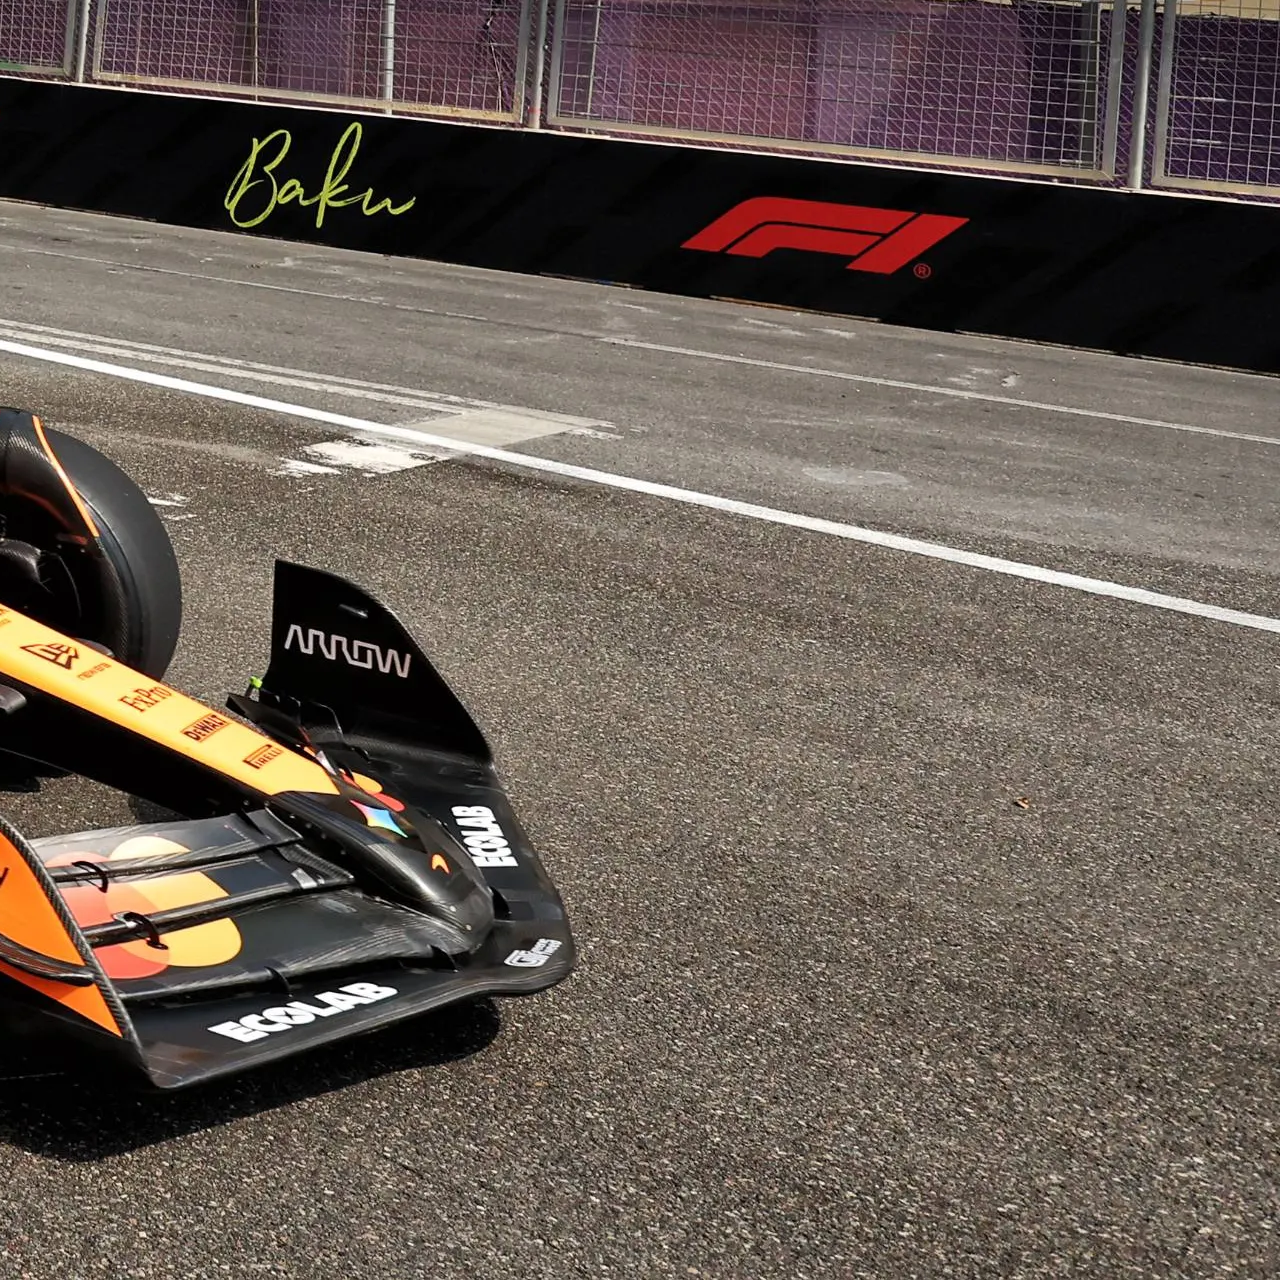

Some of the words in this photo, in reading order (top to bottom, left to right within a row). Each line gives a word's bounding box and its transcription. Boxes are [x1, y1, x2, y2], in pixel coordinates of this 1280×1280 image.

[224, 122, 417, 228] Baku
[284, 624, 412, 678] ARROW
[118, 685, 173, 713] FxPro
[243, 744, 284, 770] PIRELLI
[451, 806, 519, 868] ECOLAB
[207, 982, 399, 1044] ECOLAB
